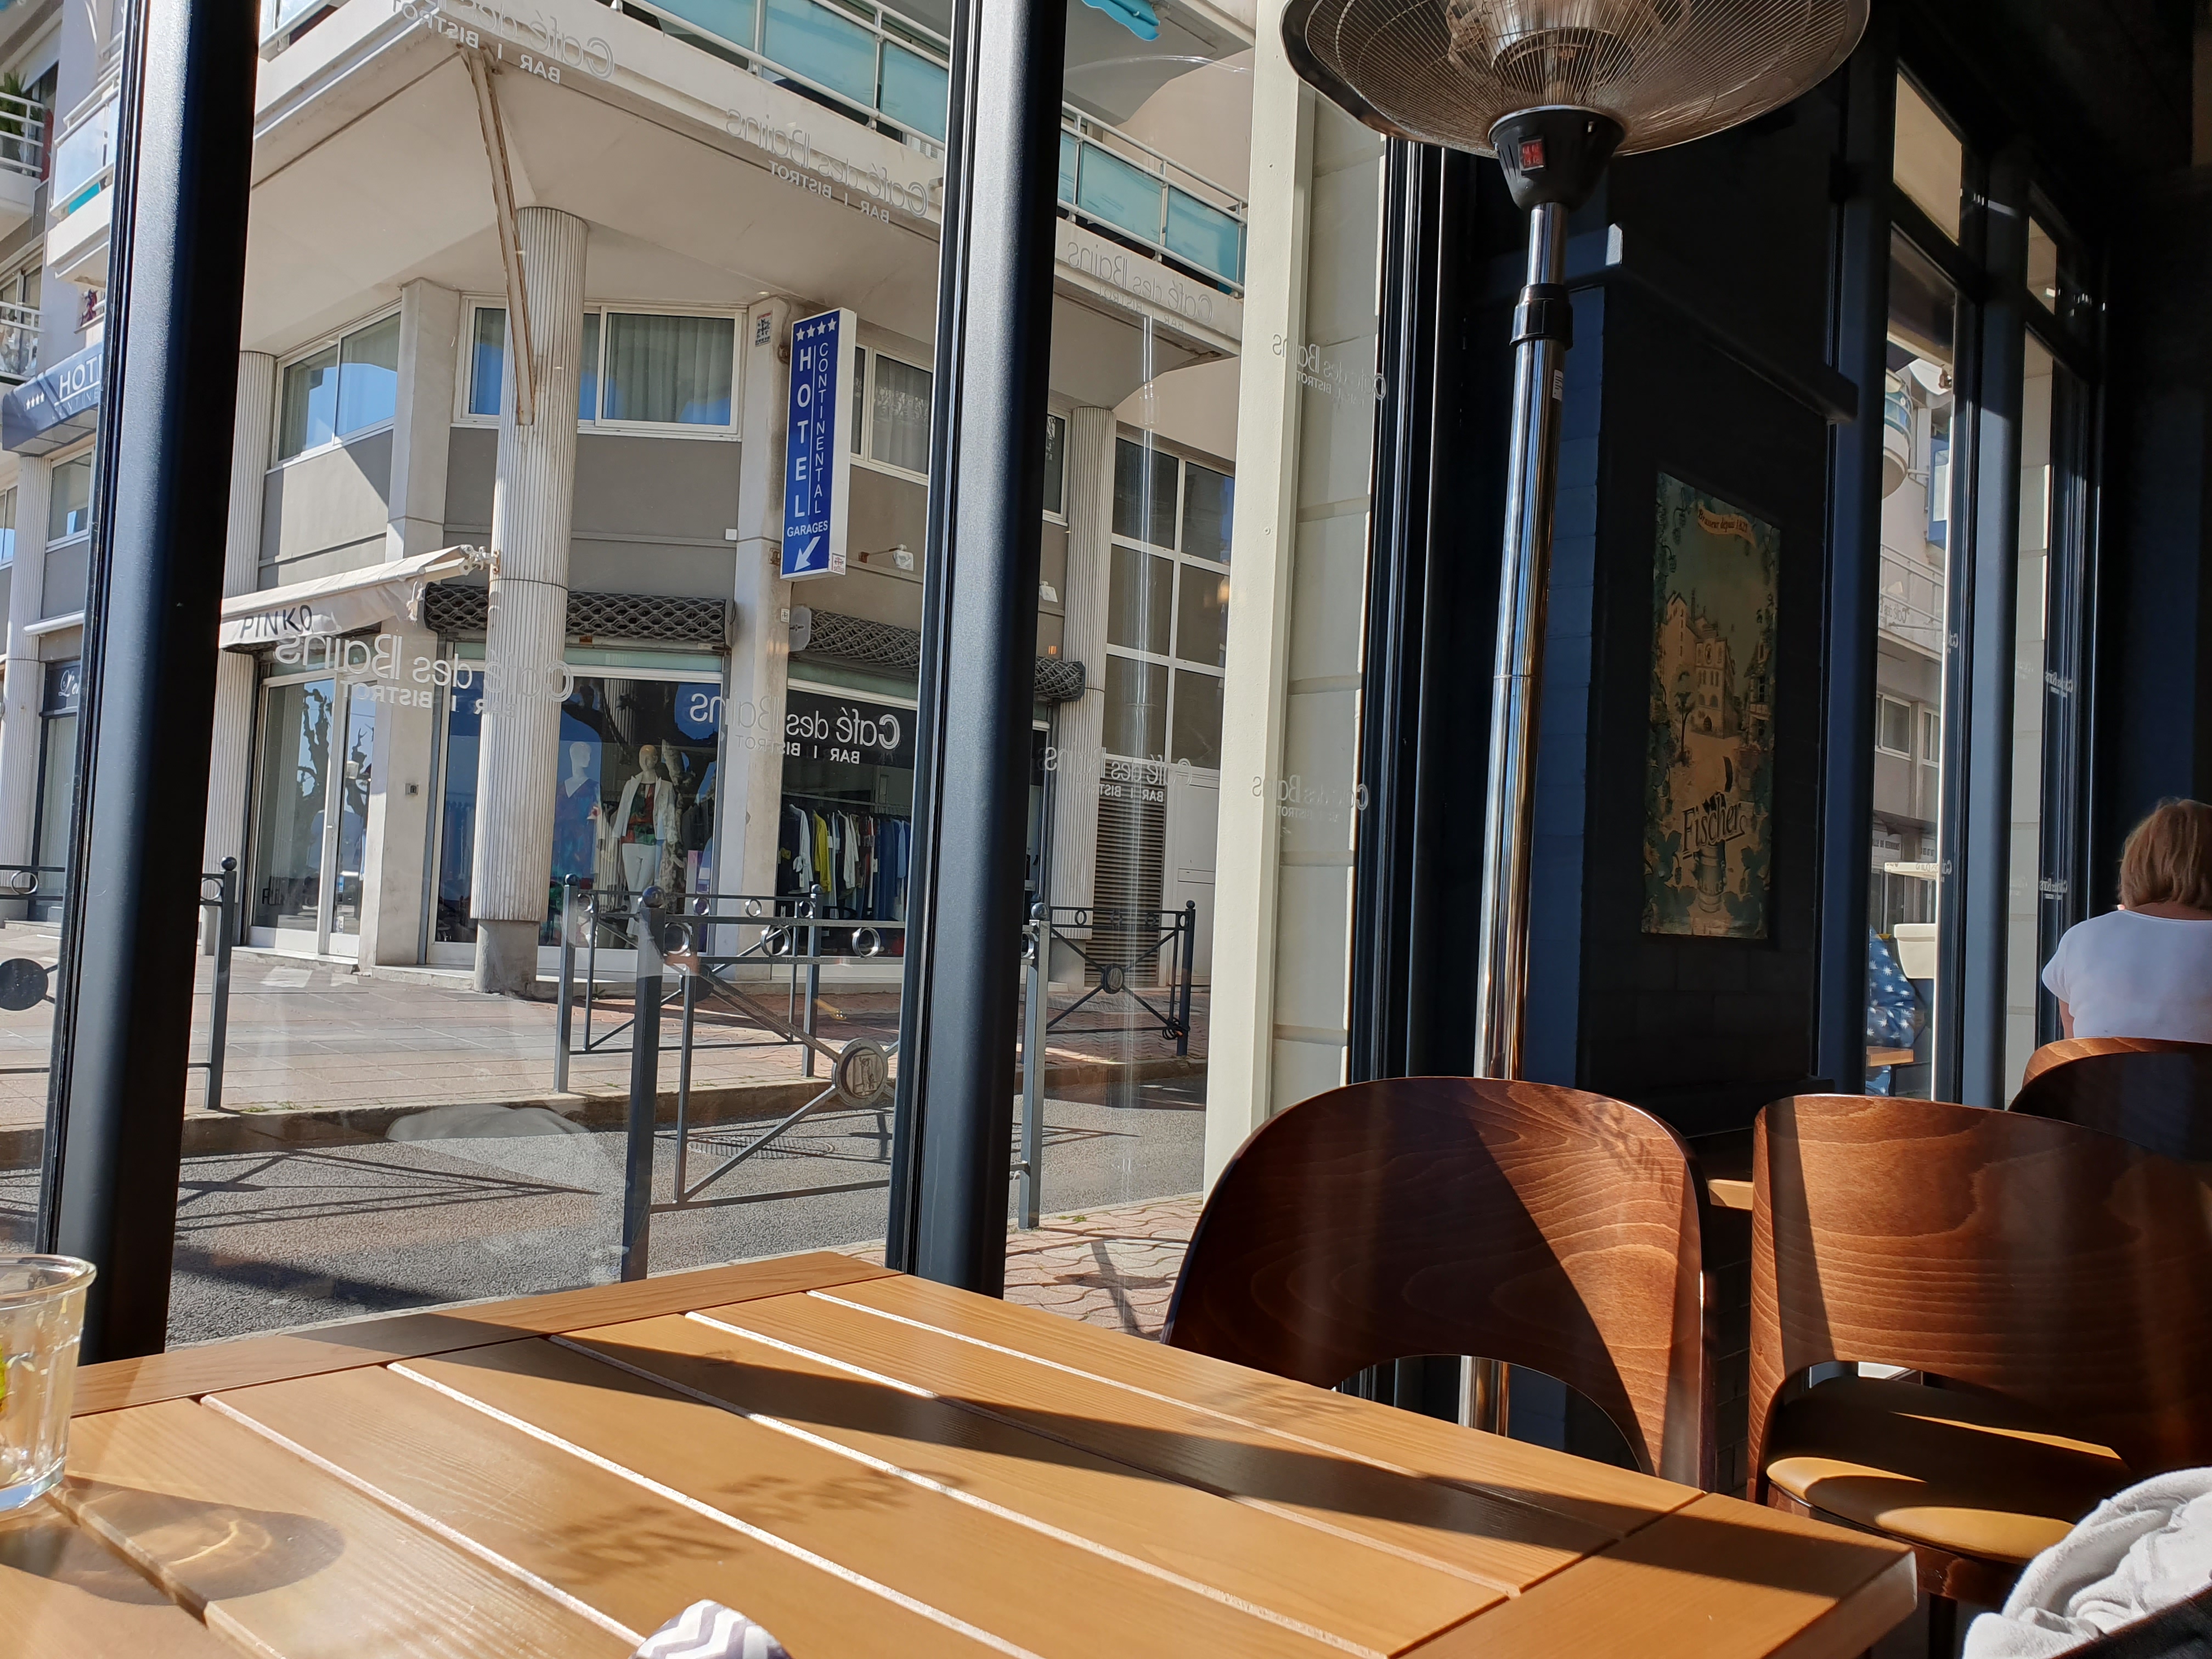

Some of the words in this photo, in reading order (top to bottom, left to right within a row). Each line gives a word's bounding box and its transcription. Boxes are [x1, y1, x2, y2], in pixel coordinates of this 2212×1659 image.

[794, 346, 812, 518] HOTEL
[814, 342, 829, 514] CONTINENTAL
[787, 520, 828, 537] GARAGES
[240, 605, 313, 638] PINKO
[1682, 792, 1738, 853] Fischer
